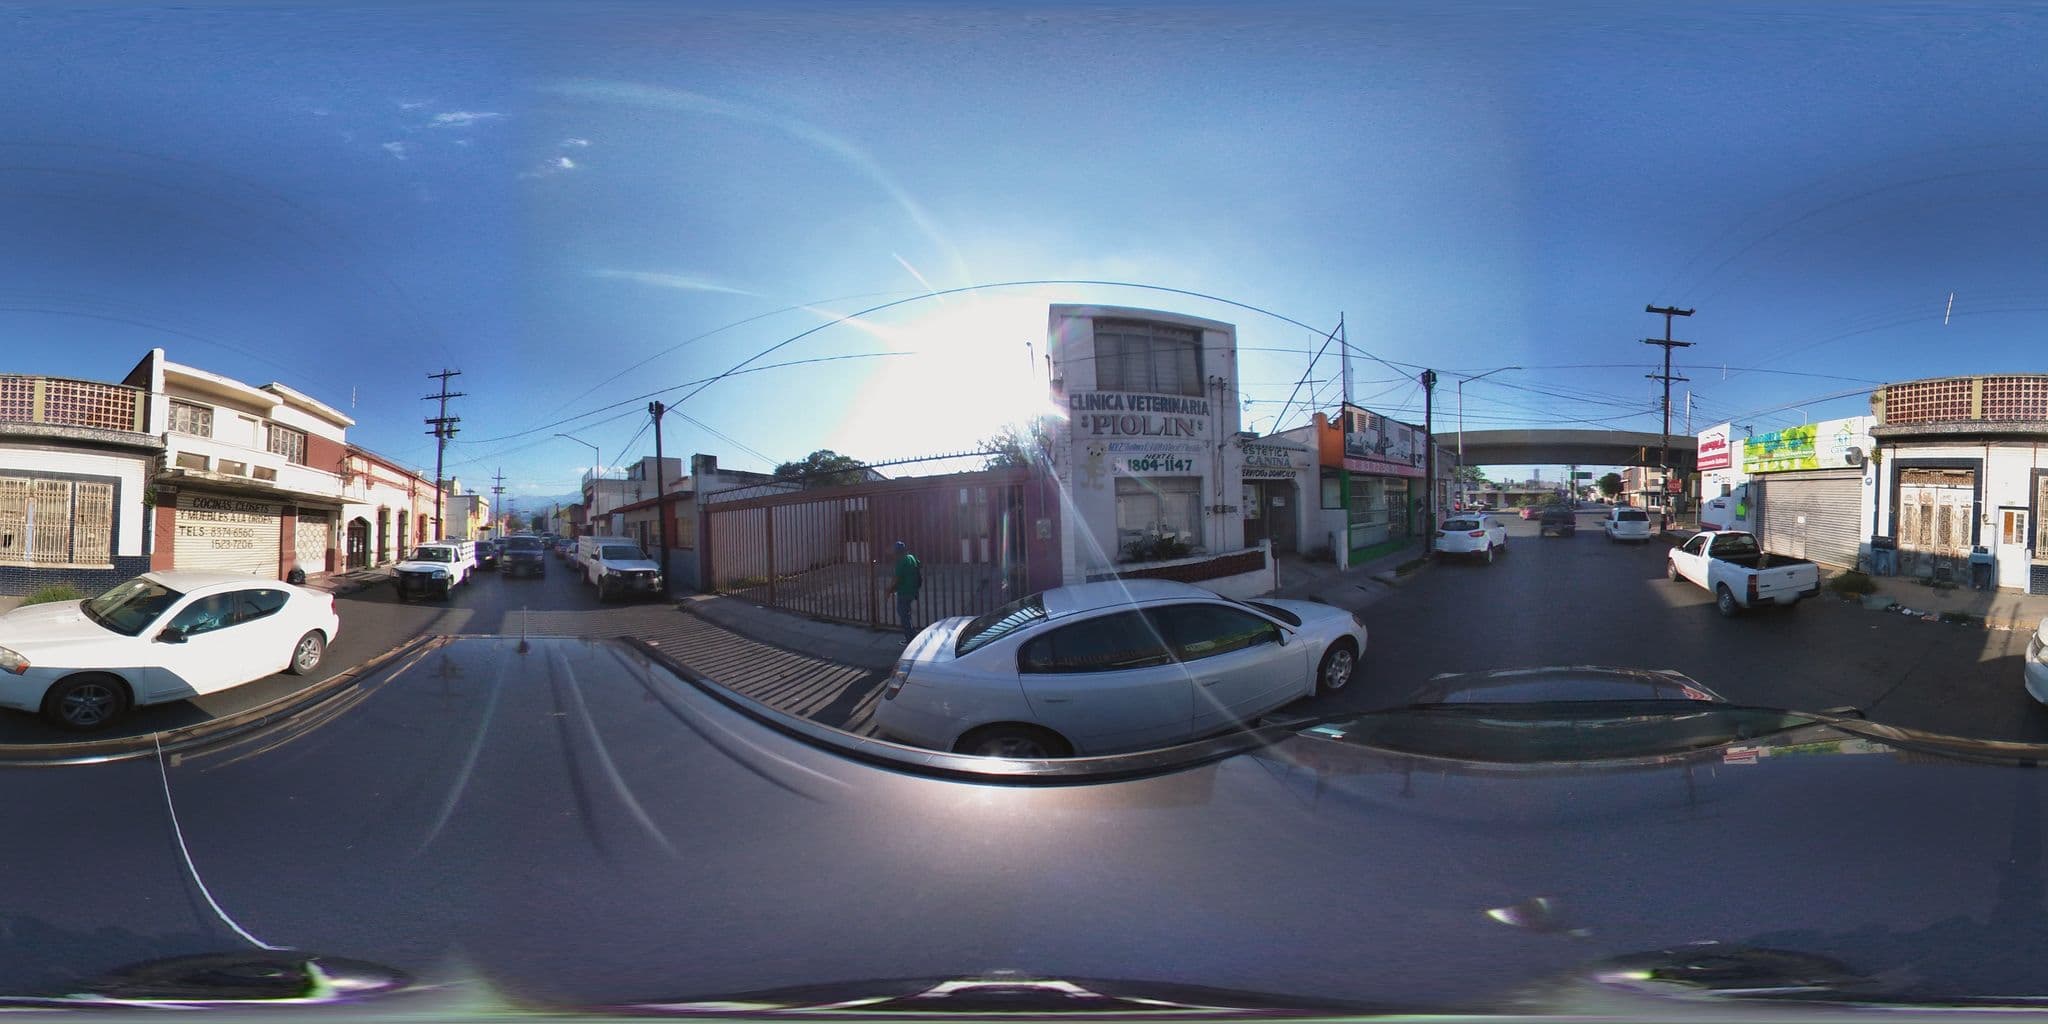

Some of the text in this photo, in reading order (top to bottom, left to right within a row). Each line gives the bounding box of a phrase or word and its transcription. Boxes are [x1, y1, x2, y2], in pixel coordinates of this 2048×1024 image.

[1070, 394, 1210, 416] CLINICA VETERINARIA
[1128, 459, 1192, 471] 1804-1147
[1246, 455, 1291, 466] CANINA
